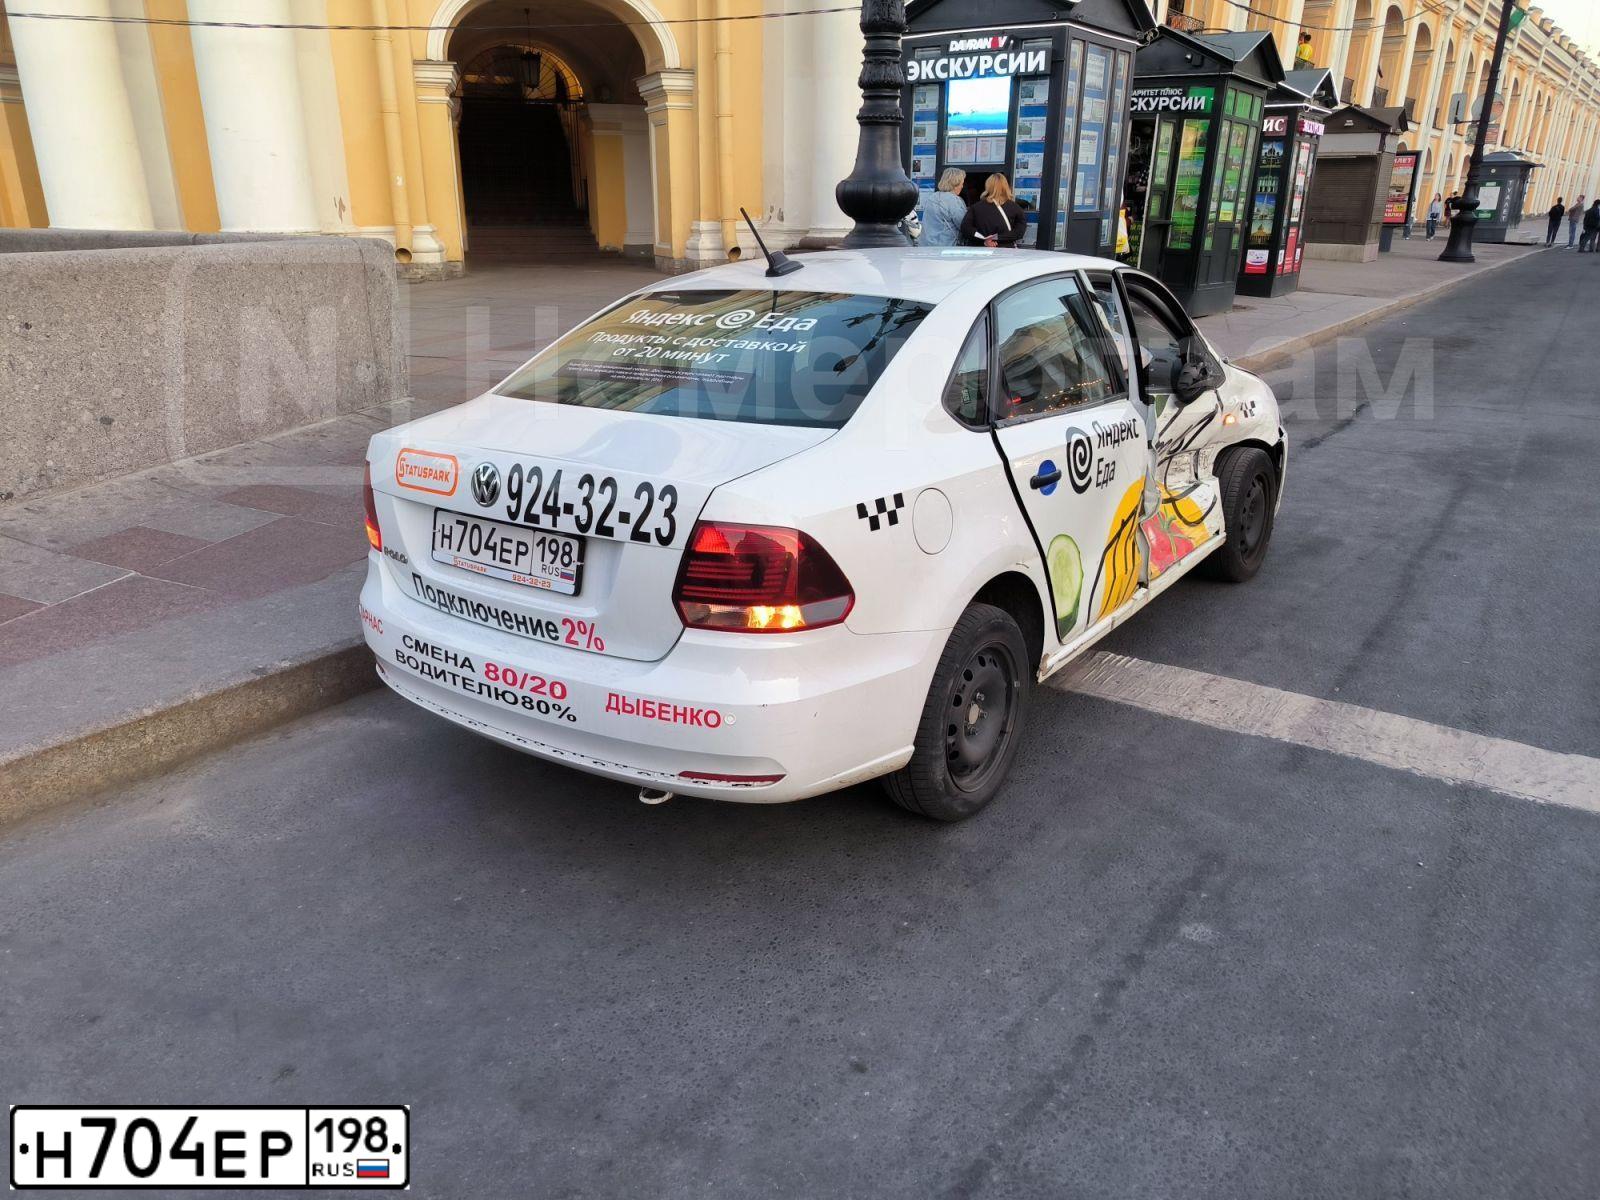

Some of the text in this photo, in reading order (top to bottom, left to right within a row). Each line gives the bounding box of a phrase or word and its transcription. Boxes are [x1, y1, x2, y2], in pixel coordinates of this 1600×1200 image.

[907, 50, 1046, 81] ЭКСКУРСИИ
[1130, 96, 1206, 111] СКУРСИИ
[1160, 88, 1183, 96] ПЛЮС
[1262, 118, 1285, 132] ИС
[1501, 180, 1513, 221] ТУАЛЕТ
[622, 310, 818, 332] Яндекс Еда
[587, 331, 808, 352] Продукты с доставкой
[613, 345, 731, 365] от 20 минут
[1092, 418, 1139, 449] Яндекс
[398, 456, 451, 483] STATUSPARK
[1095, 457, 1116, 490] Еда
[506, 463, 678, 547] 924-32-23
[440, 519, 573, 568] Н704ЕР 198
[512, 574, 552, 588] 924-32-23
[541, 563, 560, 577] RUS
[412, 572, 605, 651] Подключение 2%
[402, 634, 567, 701] СМЕНА 80/20
[605, 692, 722, 728] ДЫБЕНКО
